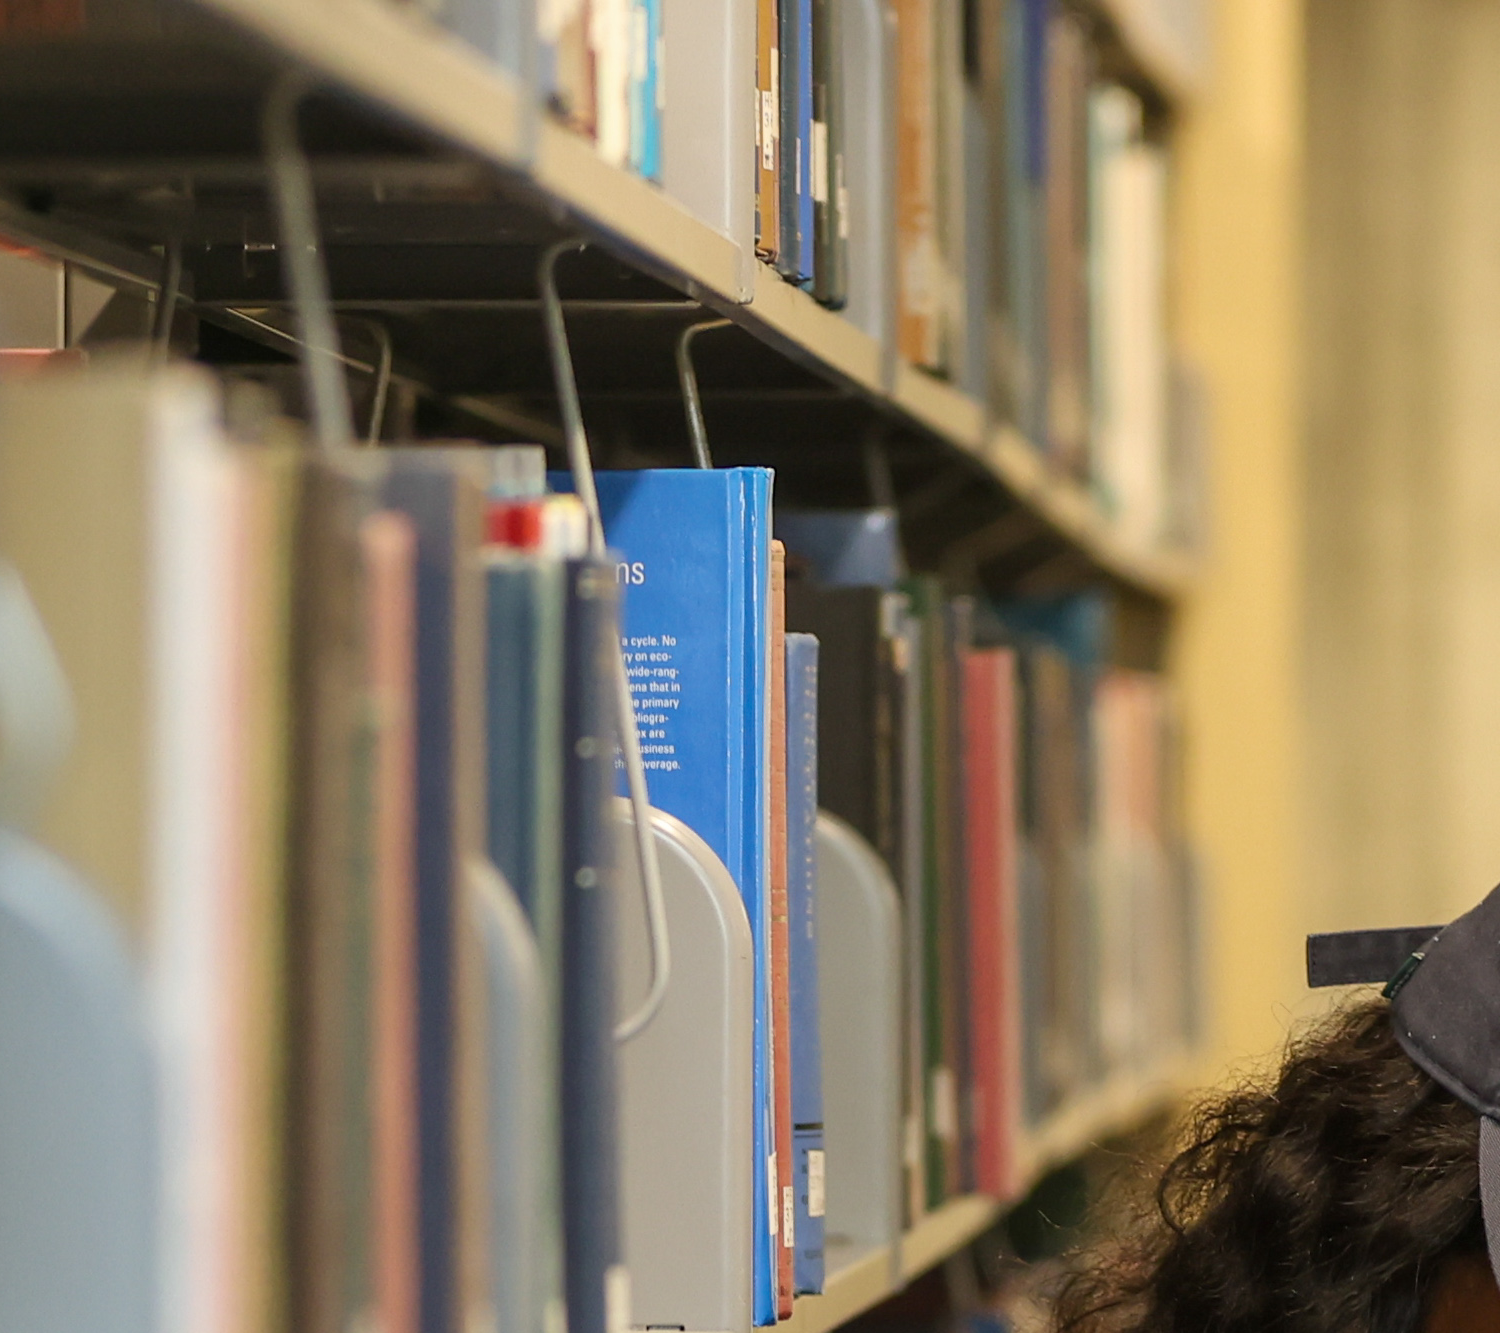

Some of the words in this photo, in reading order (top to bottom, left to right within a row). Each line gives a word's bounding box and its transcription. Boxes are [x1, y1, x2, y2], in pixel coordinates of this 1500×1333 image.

[630, 635, 660, 649] cycle.
[662, 634, 677, 647] No
[635, 652, 648, 662] on
[649, 652, 672, 662] eco-
[649, 681, 669, 692] that
[671, 681, 681, 692] in
[642, 697, 680, 710] primary
[648, 729, 666, 739] are
